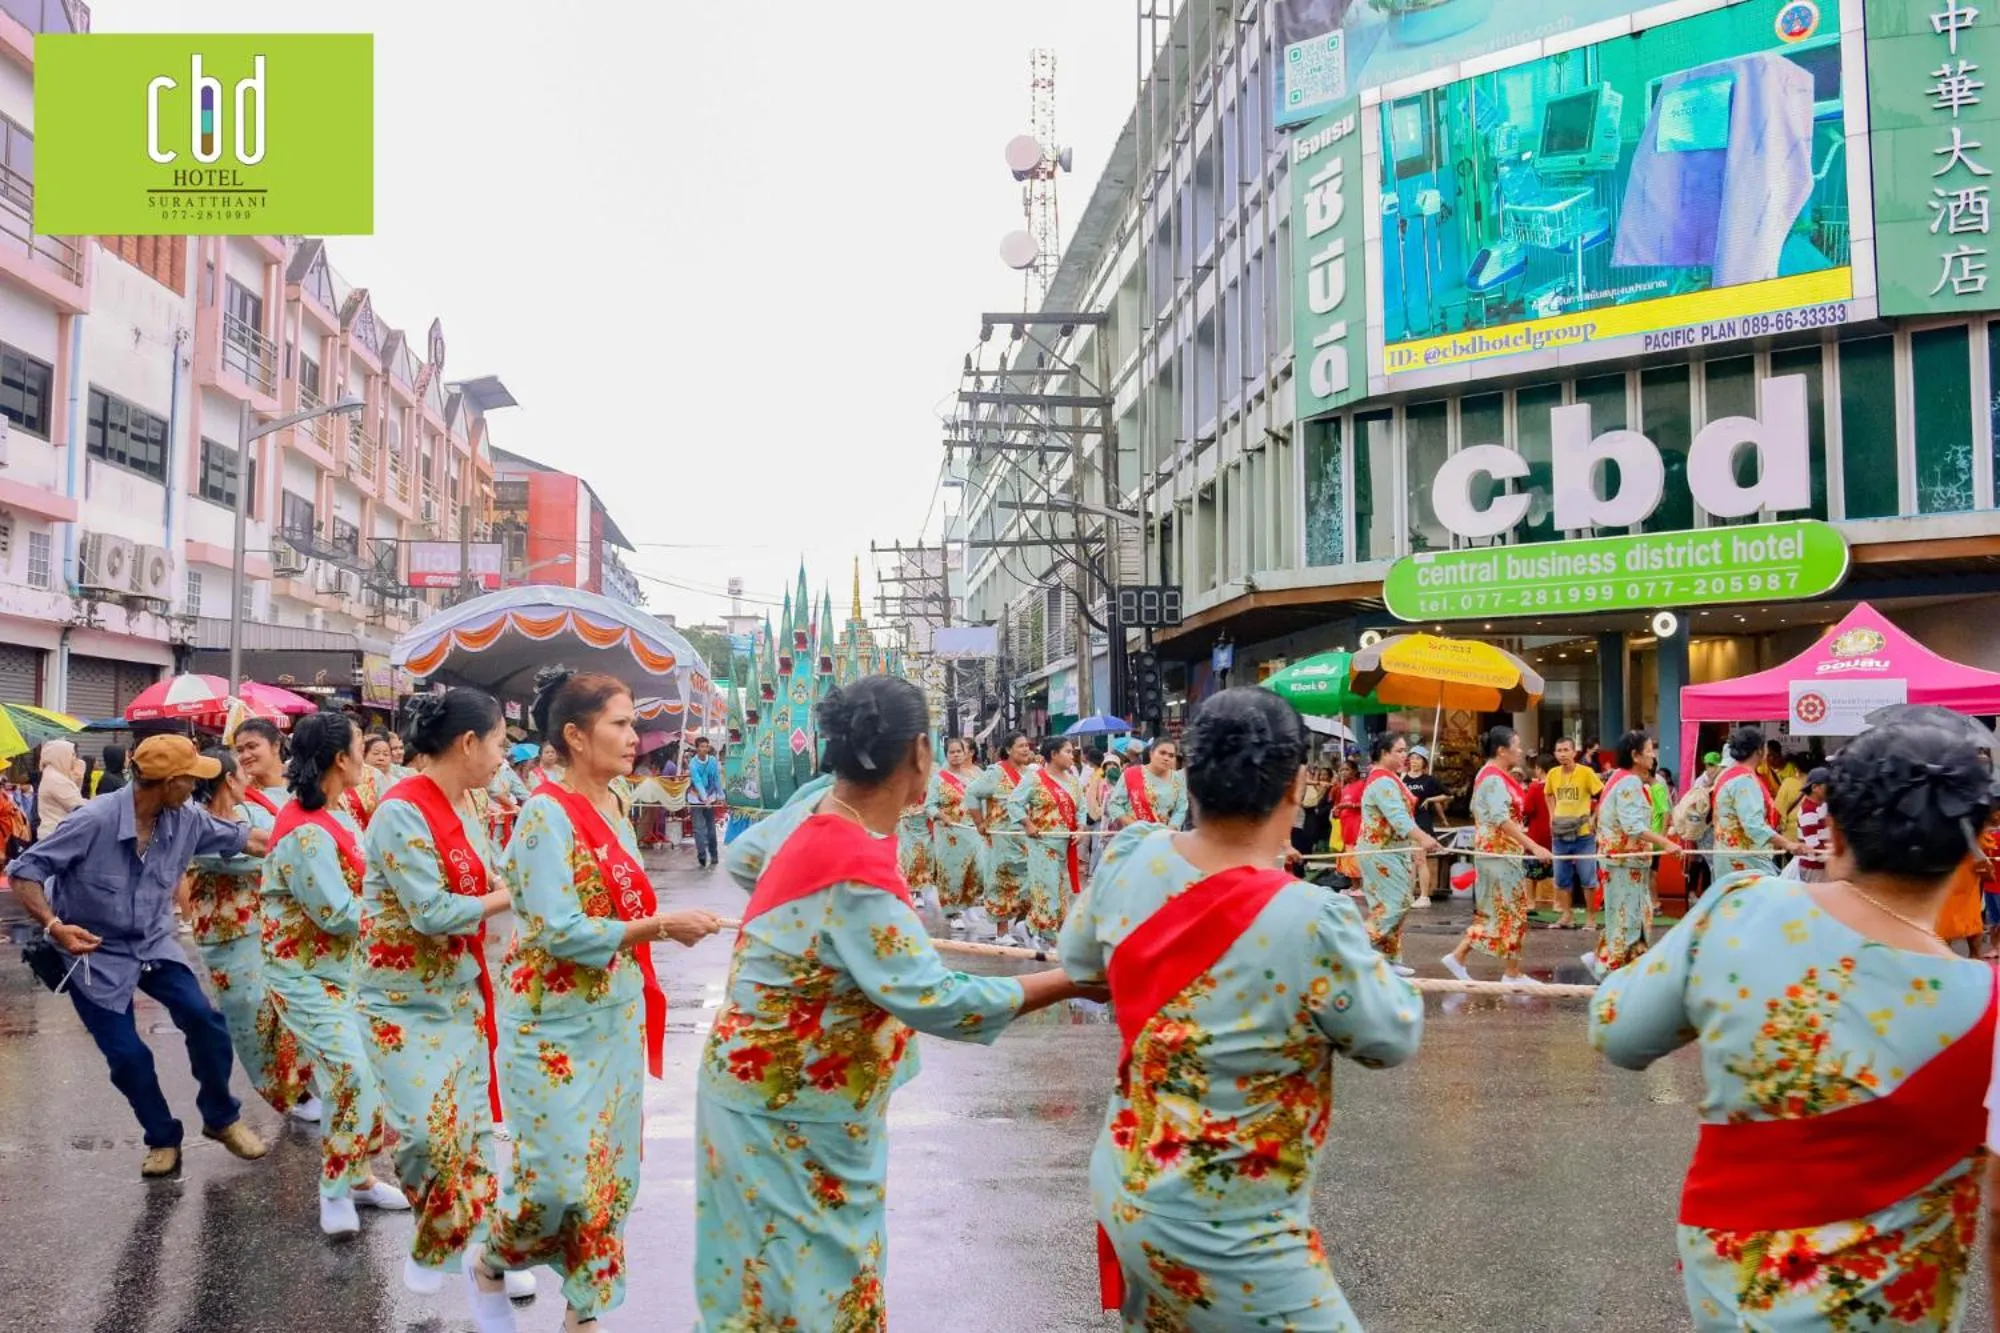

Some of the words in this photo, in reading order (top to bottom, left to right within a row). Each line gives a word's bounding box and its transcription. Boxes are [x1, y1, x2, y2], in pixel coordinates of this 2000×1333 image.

[1293, 114, 1355, 164] โรงแรม
[1925, 0, 1993, 297] 中華大酒店
[1389, 349, 1418, 367] ID:
[1424, 323, 1597, 365] @cbdhotelgroup
[1644, 328, 1695, 351] PACIFIC
[1701, 321, 1736, 342] PLAN
[1742, 304, 1846, 337] 089-66-33333
[1432, 373, 1811, 537] cbd
[1417, 555, 1498, 586] central
[1506, 551, 1616, 580] business
[1626, 538, 1723, 571] district
[1732, 530, 1803, 563] hotel
[1626, 572, 1799, 599] 077-205987
